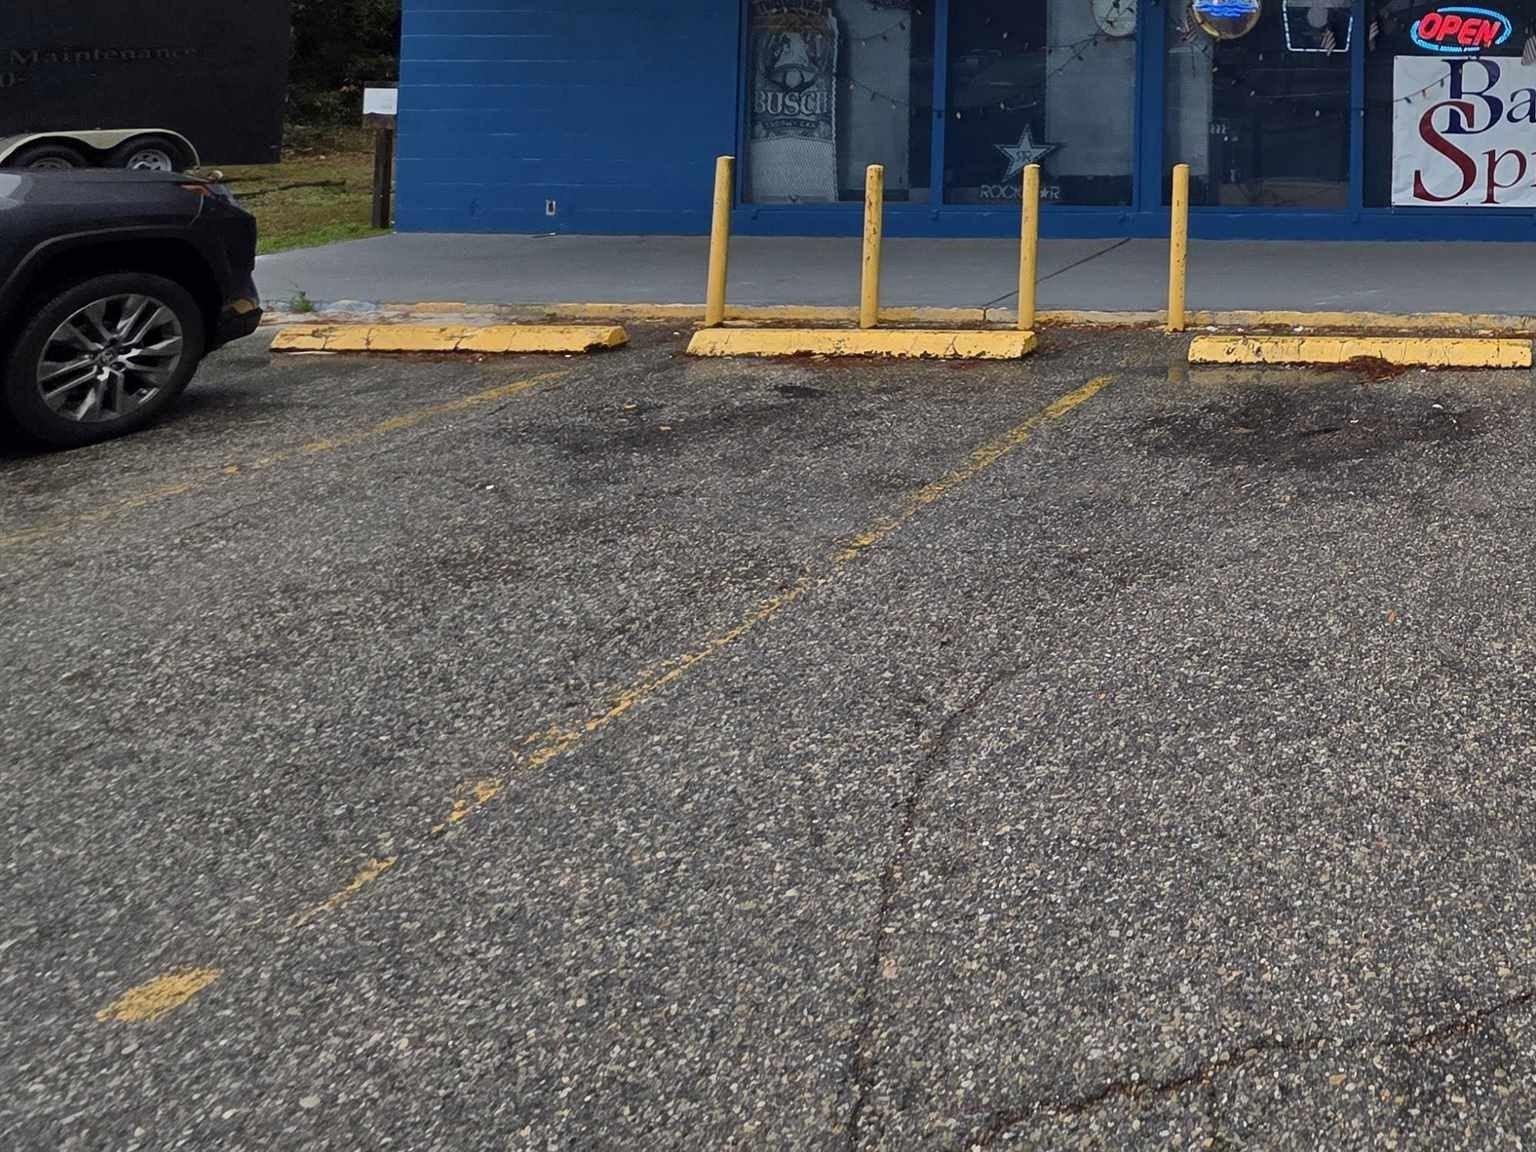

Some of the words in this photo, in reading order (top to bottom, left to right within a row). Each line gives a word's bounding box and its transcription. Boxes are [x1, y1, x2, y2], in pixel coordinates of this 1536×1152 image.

[1418, 12, 1501, 48] OPEN
[10, 47, 202, 65] Maintenance
[753, 90, 829, 116] BUSCH
